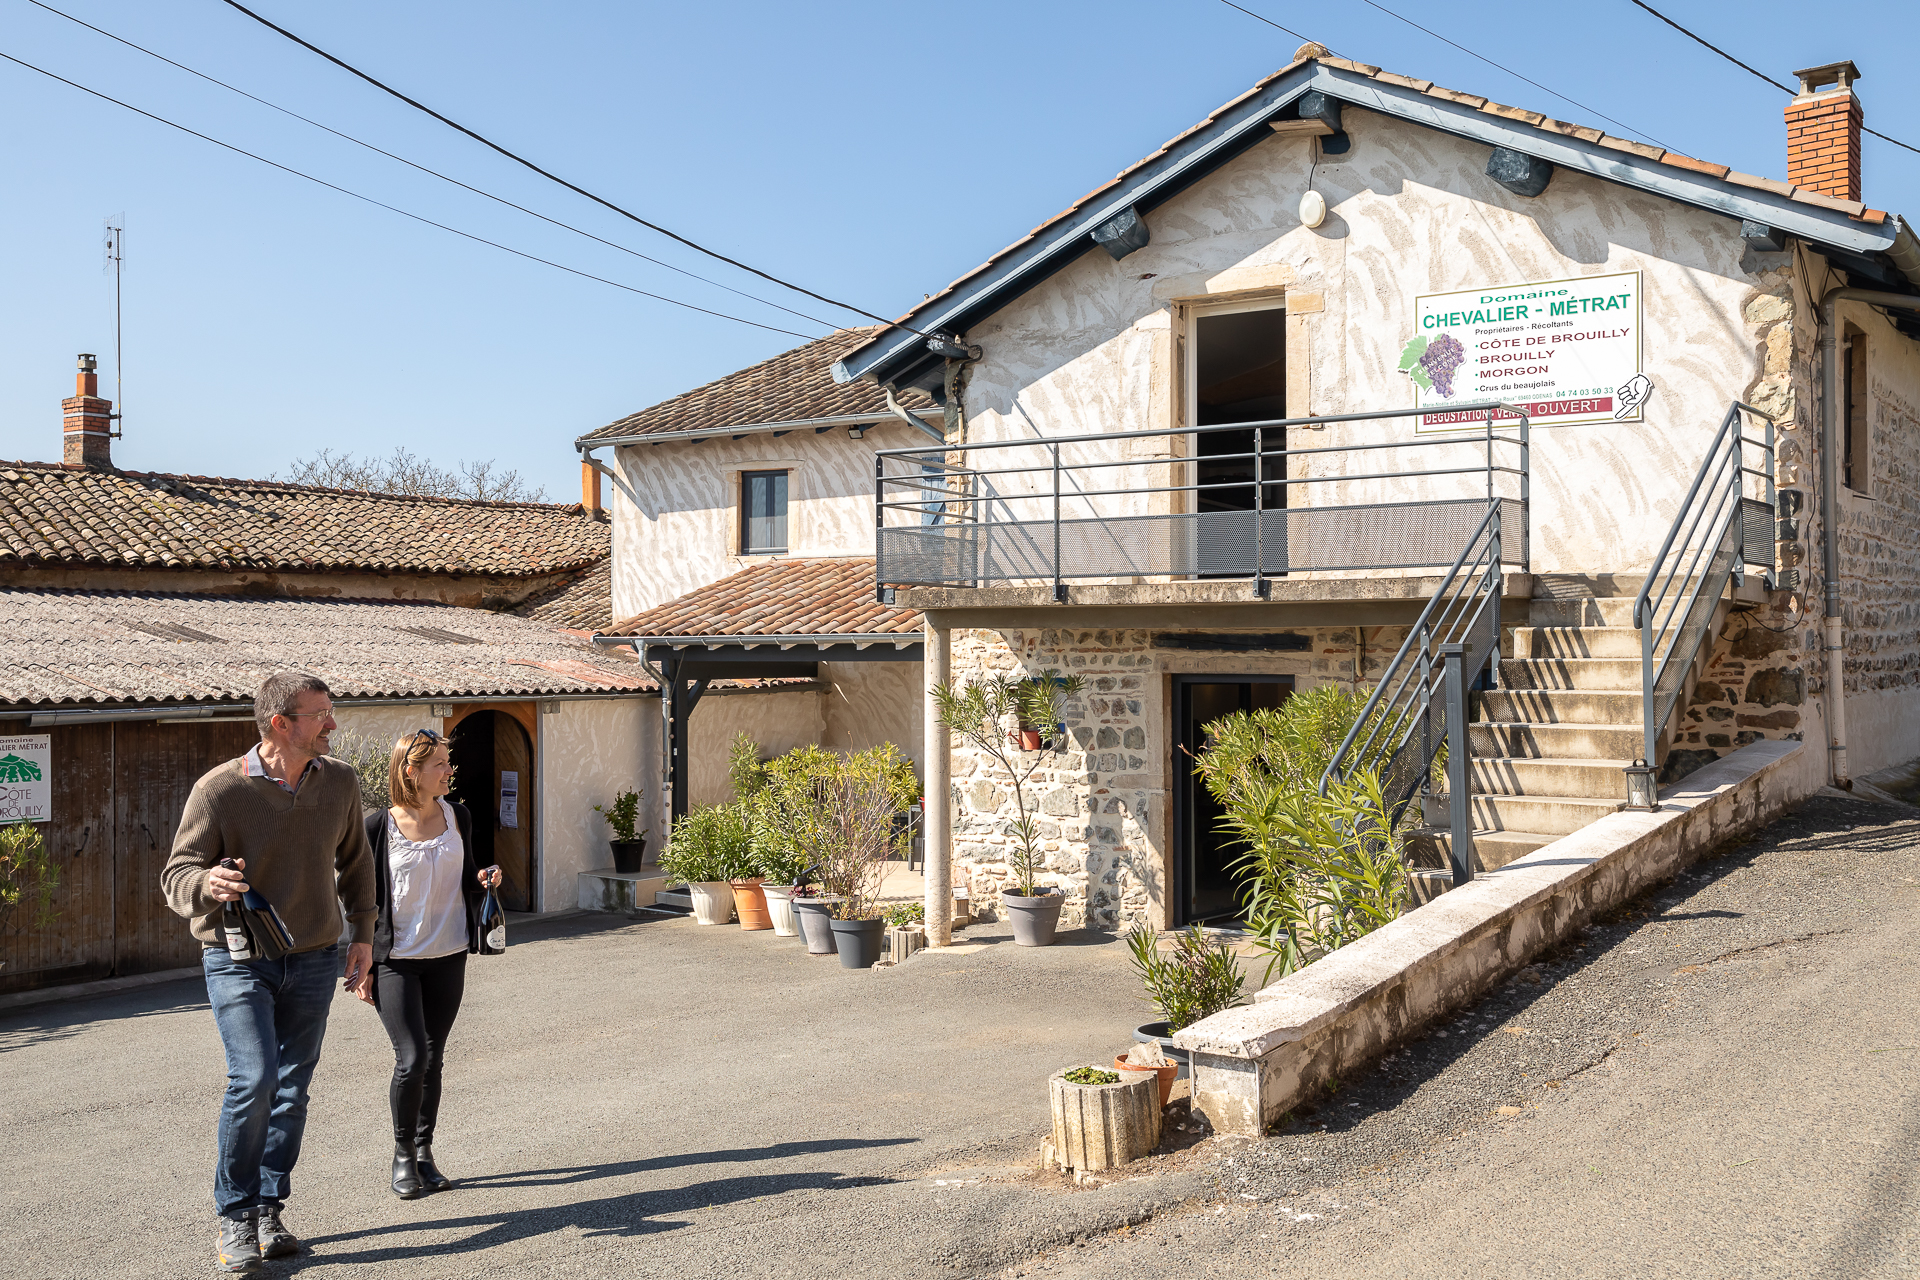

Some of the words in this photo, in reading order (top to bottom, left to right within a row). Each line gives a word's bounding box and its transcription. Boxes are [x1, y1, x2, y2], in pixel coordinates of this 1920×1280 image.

[1480, 289, 1568, 304] Domaine
[1423, 305, 1529, 329] CHEVALIER
[1550, 295, 1631, 316] MÉTRAT
[1475, 325, 1524, 335] Propriétaires
[1531, 320, 1574, 330] Récoltants
[1480, 338, 1521, 350] CÔTE
[1526, 336, 1546, 346] DE
[1552, 328, 1630, 343] BROUILLY
[1480, 350, 1555, 364] BROUILLY
[1480, 365, 1549, 379] MORGON
[1479, 384, 1499, 393] Crus
[1501, 382, 1512, 390] du
[1513, 380, 1556, 390] beaujolais
[1556, 390, 1566, 398] 04
[1592, 387, 1602, 395] 50
[1537, 399, 1601, 414] OUVERT
